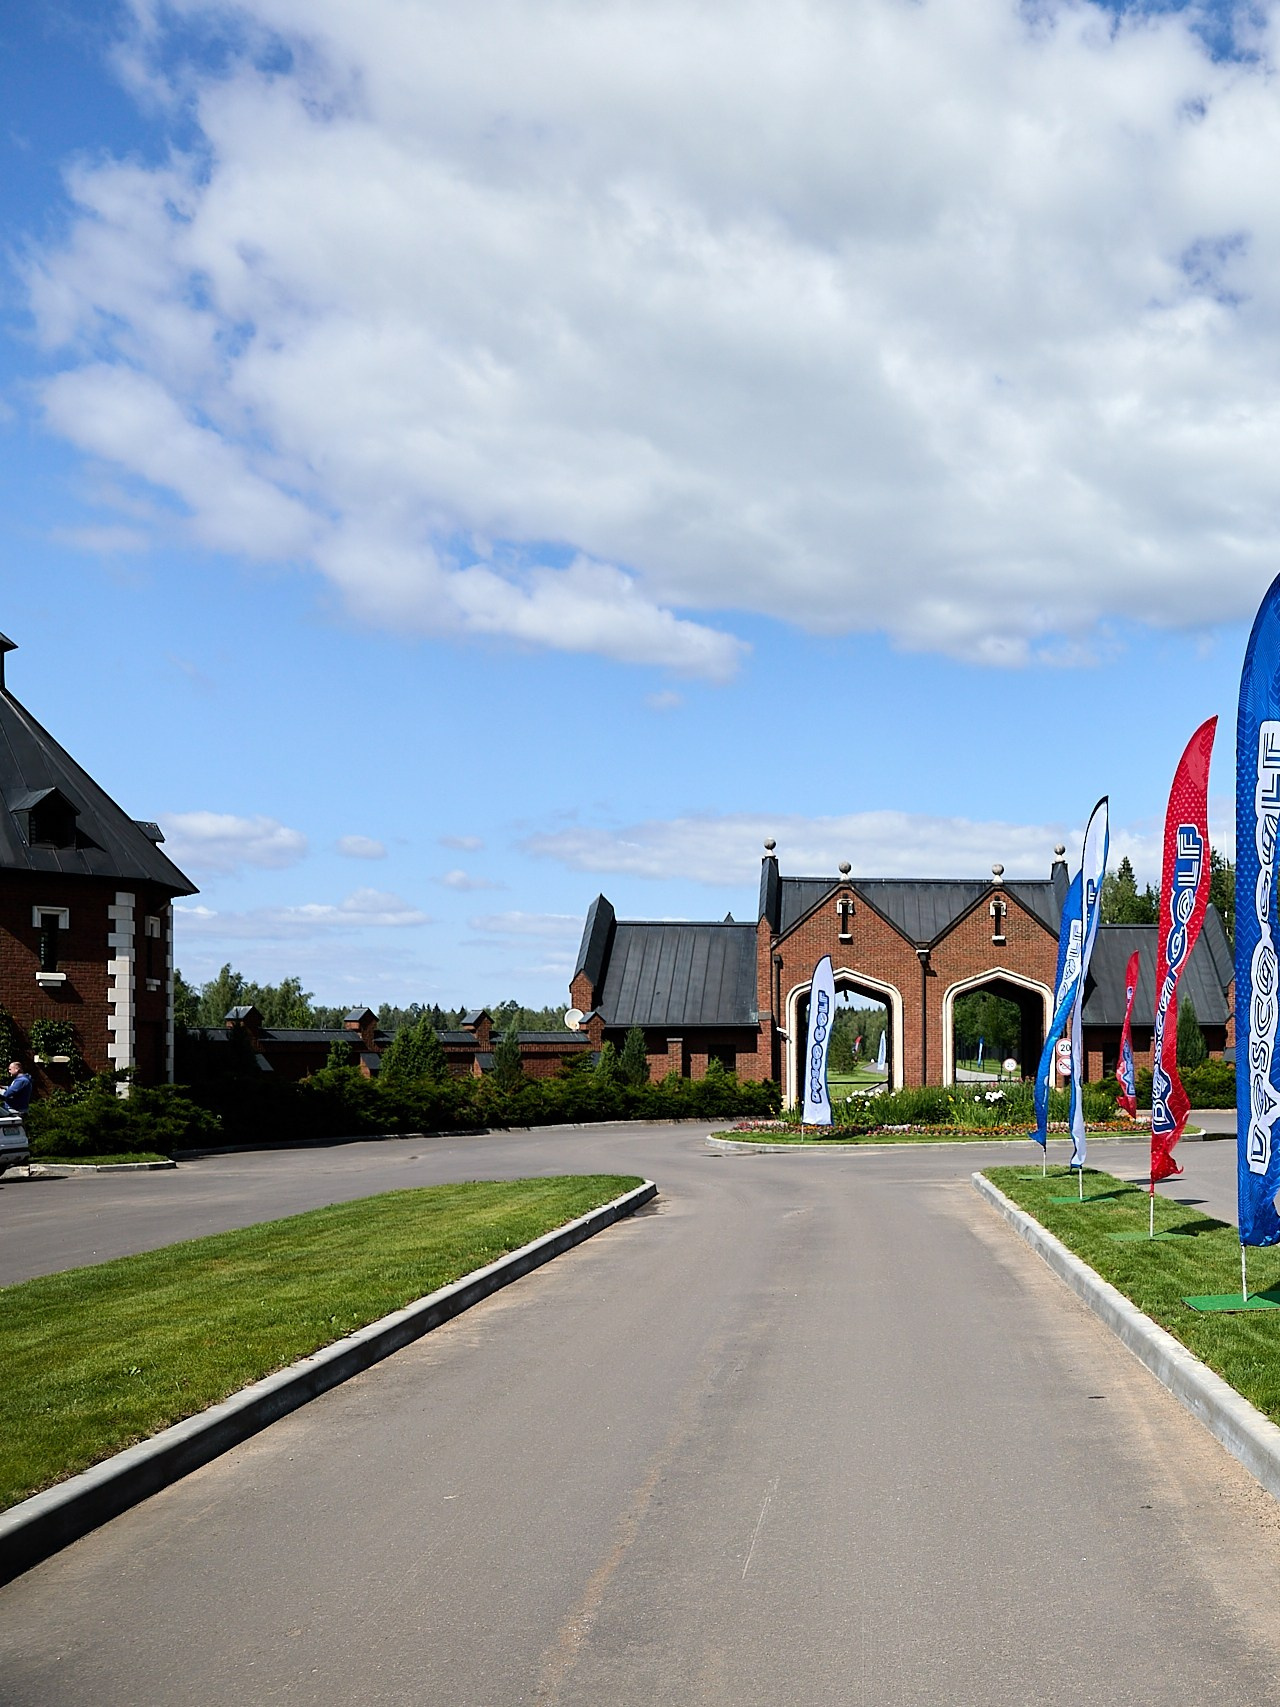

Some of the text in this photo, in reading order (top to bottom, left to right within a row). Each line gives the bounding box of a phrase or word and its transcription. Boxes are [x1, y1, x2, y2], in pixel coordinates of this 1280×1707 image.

[1169, 831, 1201, 964] GOLF
[814, 991, 829, 1042] GOLF
[1060, 1044, 1071, 1052] 20
